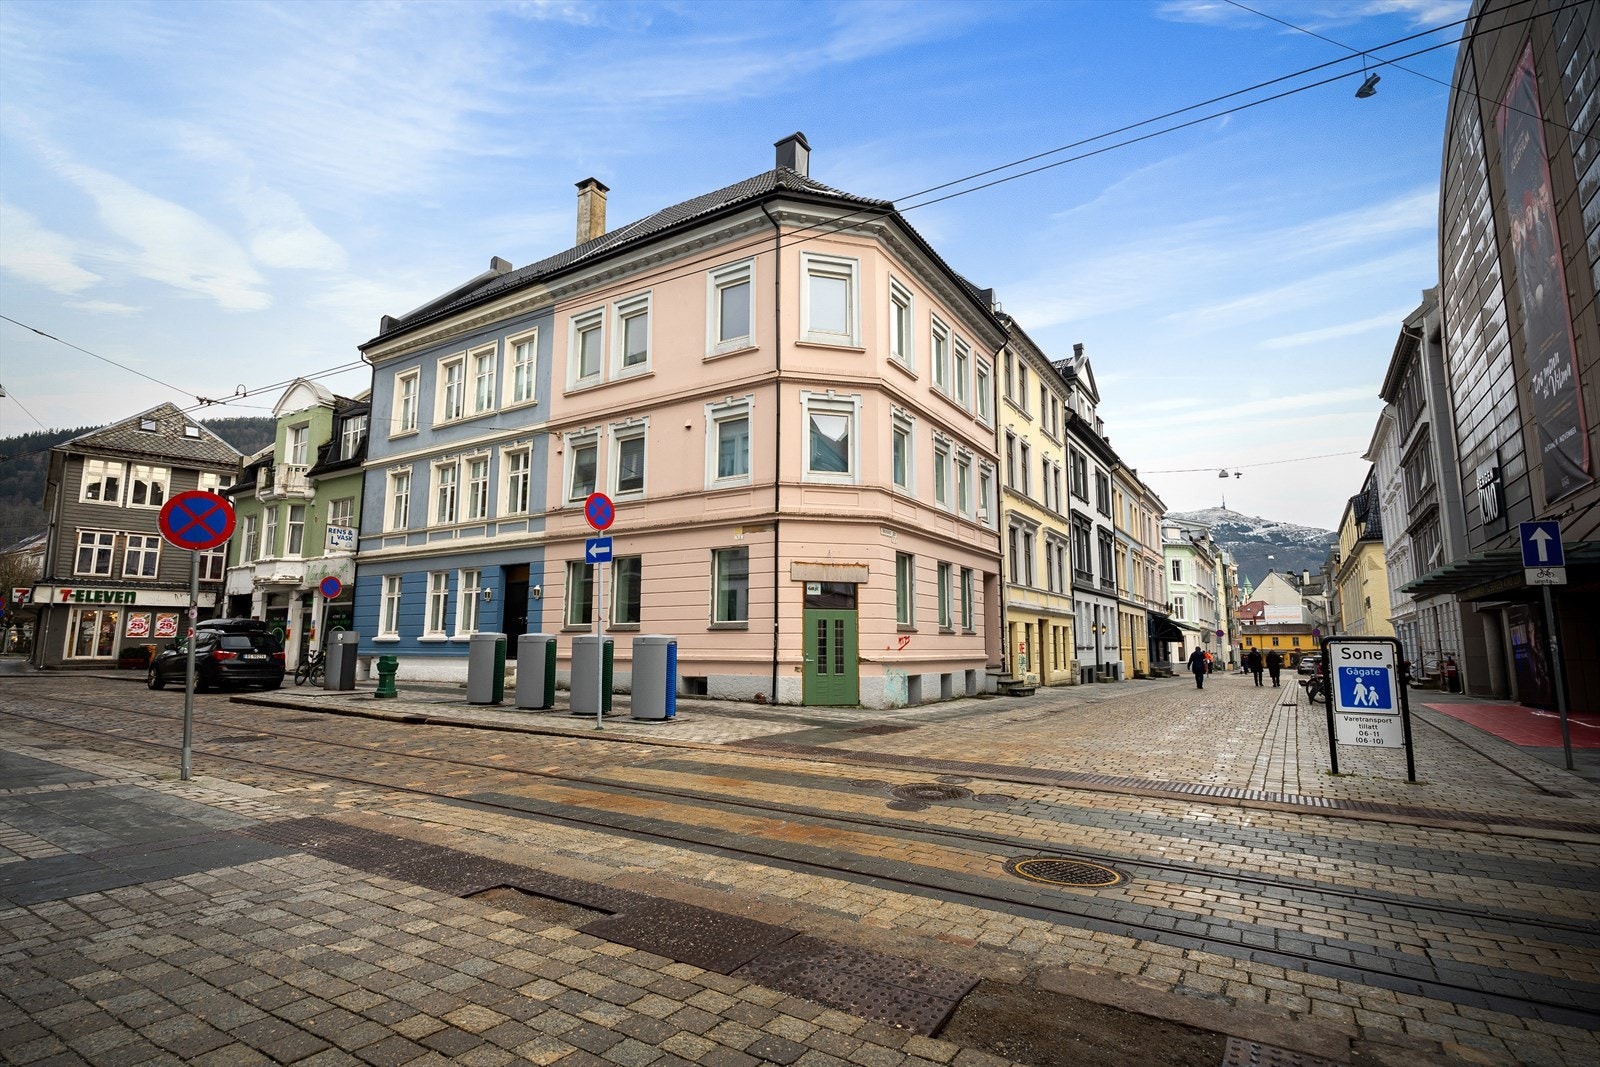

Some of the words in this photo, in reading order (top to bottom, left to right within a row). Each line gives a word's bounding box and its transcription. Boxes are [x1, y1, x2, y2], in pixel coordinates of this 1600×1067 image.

[1476, 468, 1493, 490] BERGEN
[328, 527, 346, 535] RENS
[60, 589, 137, 604] 7-ELEVEN
[1341, 647, 1383, 660] Sone
[1346, 667, 1380, 677] Gågate
[1344, 715, 1393, 725] Varetransport
